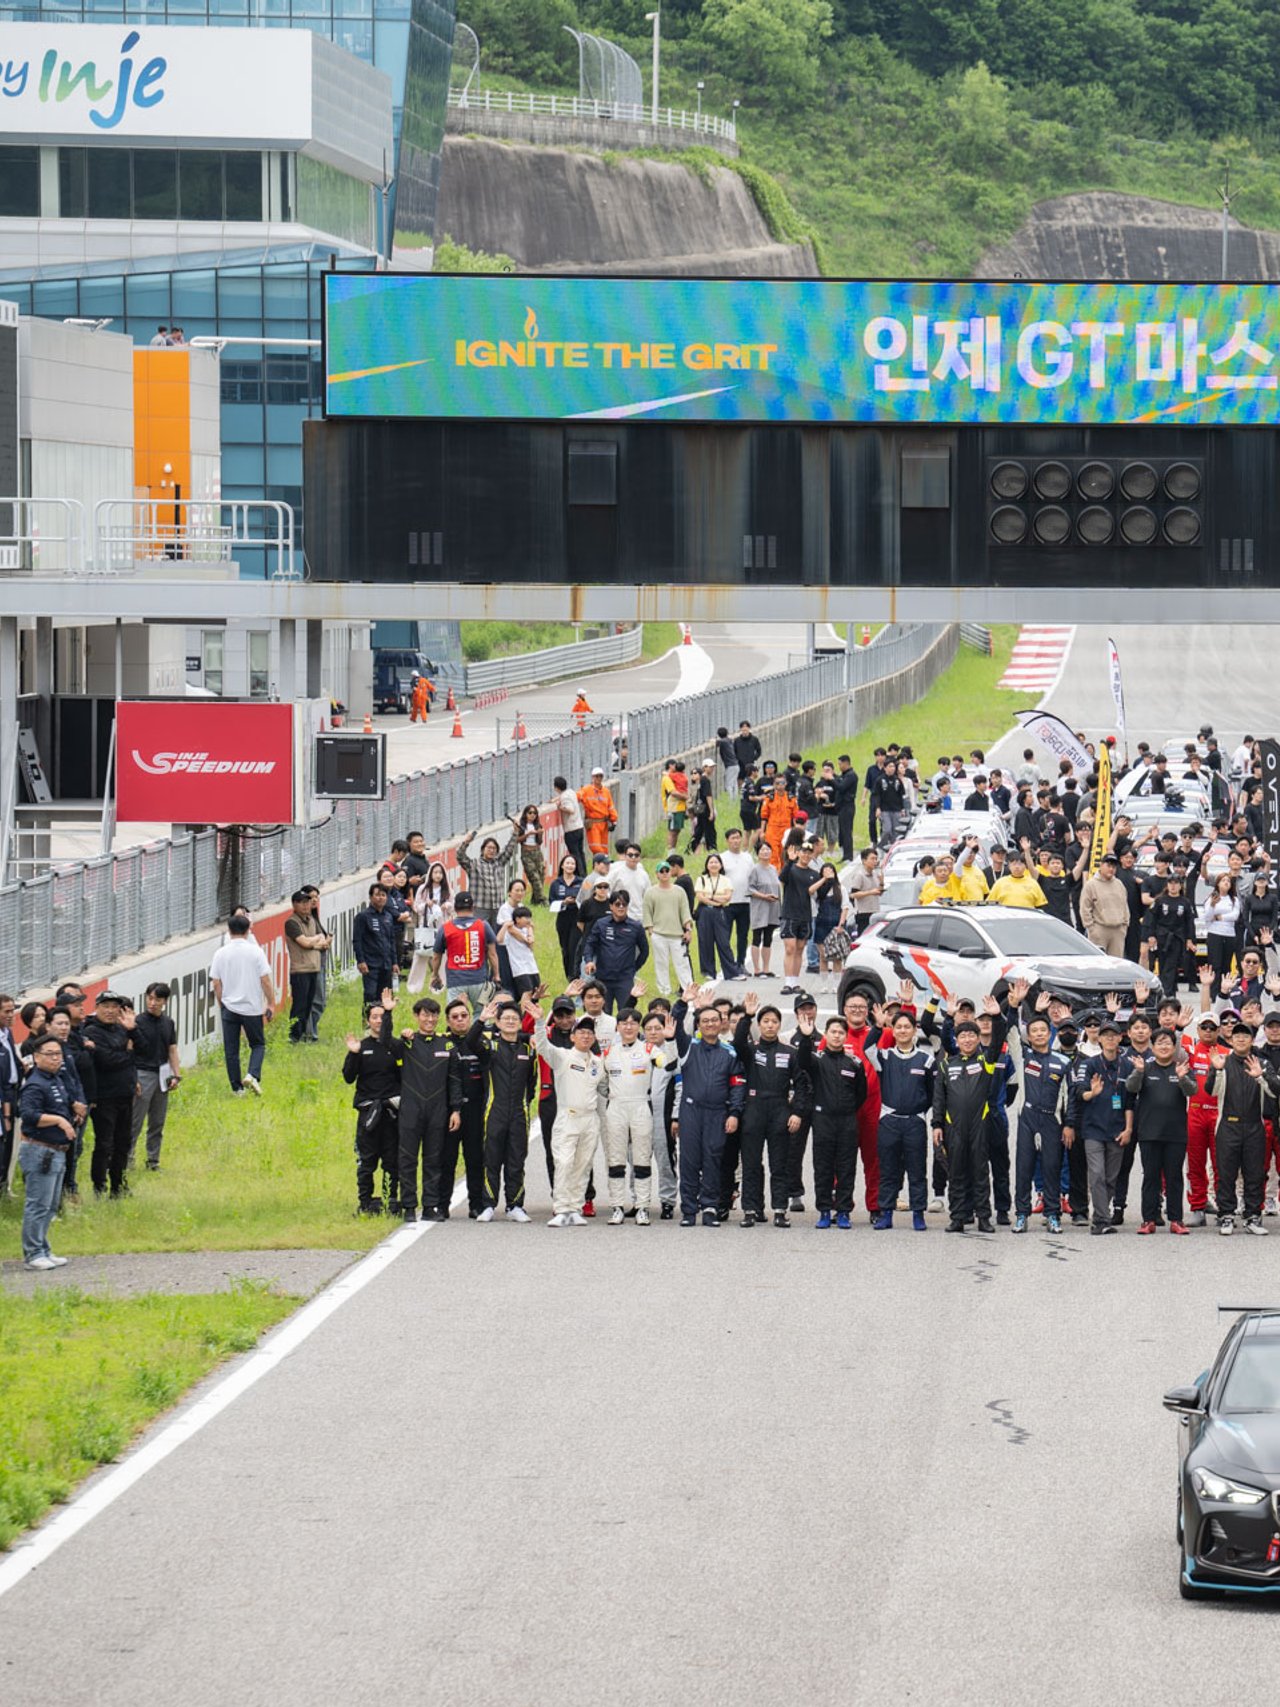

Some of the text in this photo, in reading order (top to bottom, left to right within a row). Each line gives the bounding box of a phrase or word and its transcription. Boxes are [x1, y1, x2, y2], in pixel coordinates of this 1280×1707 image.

[0, 31, 167, 129] y Inje
[455, 339, 778, 370] IGNITE THE GRIT
[863, 315, 1001, 392] 인제
[1016, 320, 1125, 389] GT
[132, 749, 277, 775] SPEEDIUM
[177, 751, 209, 761] INJE
[1266, 753, 1280, 889] OVERLIM
[453, 954, 466, 964] 04
[470, 930, 480, 964] MEDIA
[182, 965, 216, 1046] TIRE
